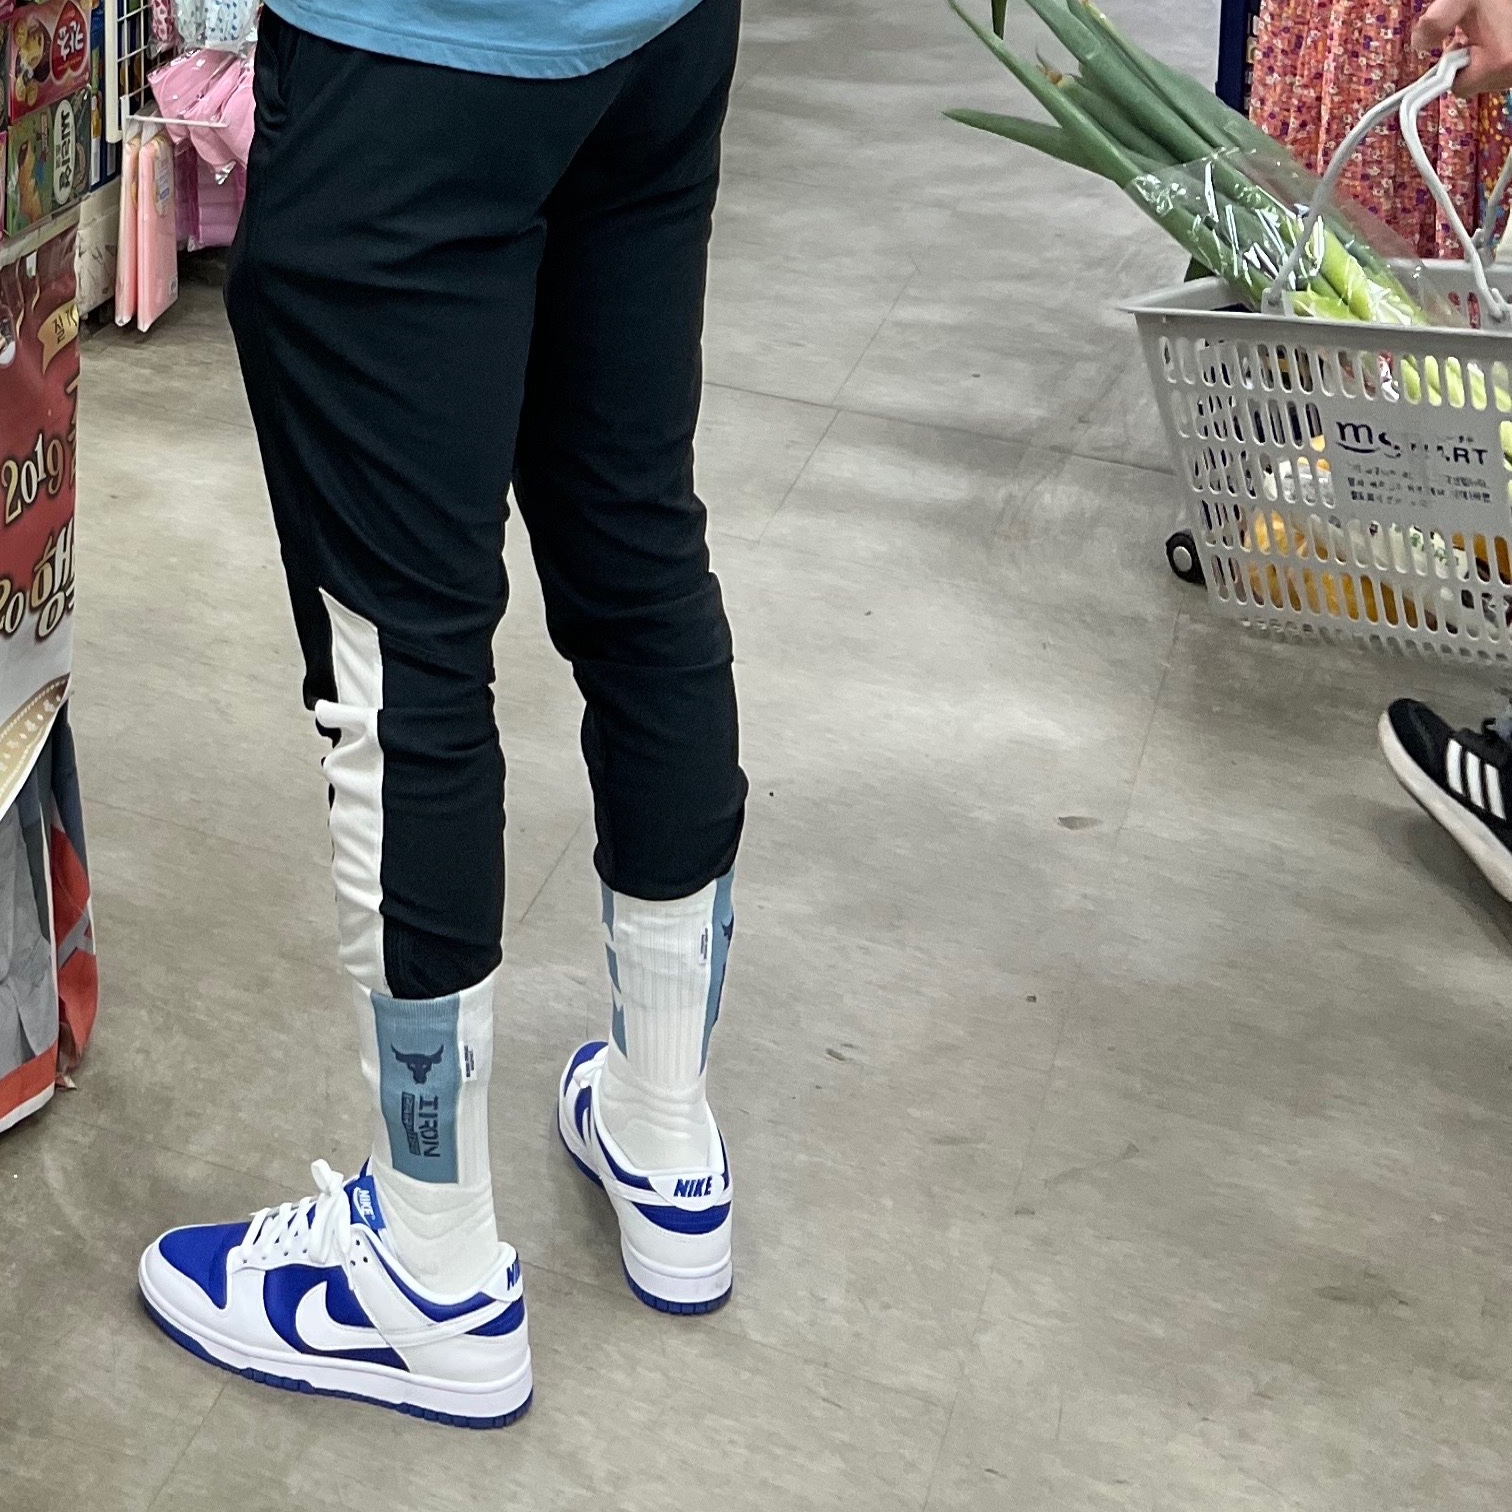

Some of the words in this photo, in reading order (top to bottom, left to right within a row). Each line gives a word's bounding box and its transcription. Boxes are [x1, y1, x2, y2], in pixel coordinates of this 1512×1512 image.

[1, 432, 65, 526] 2019
[418, 1094, 441, 1158] IRON
[356, 1187, 374, 1219] NIKE
[672, 1175, 714, 1200] NIKE
